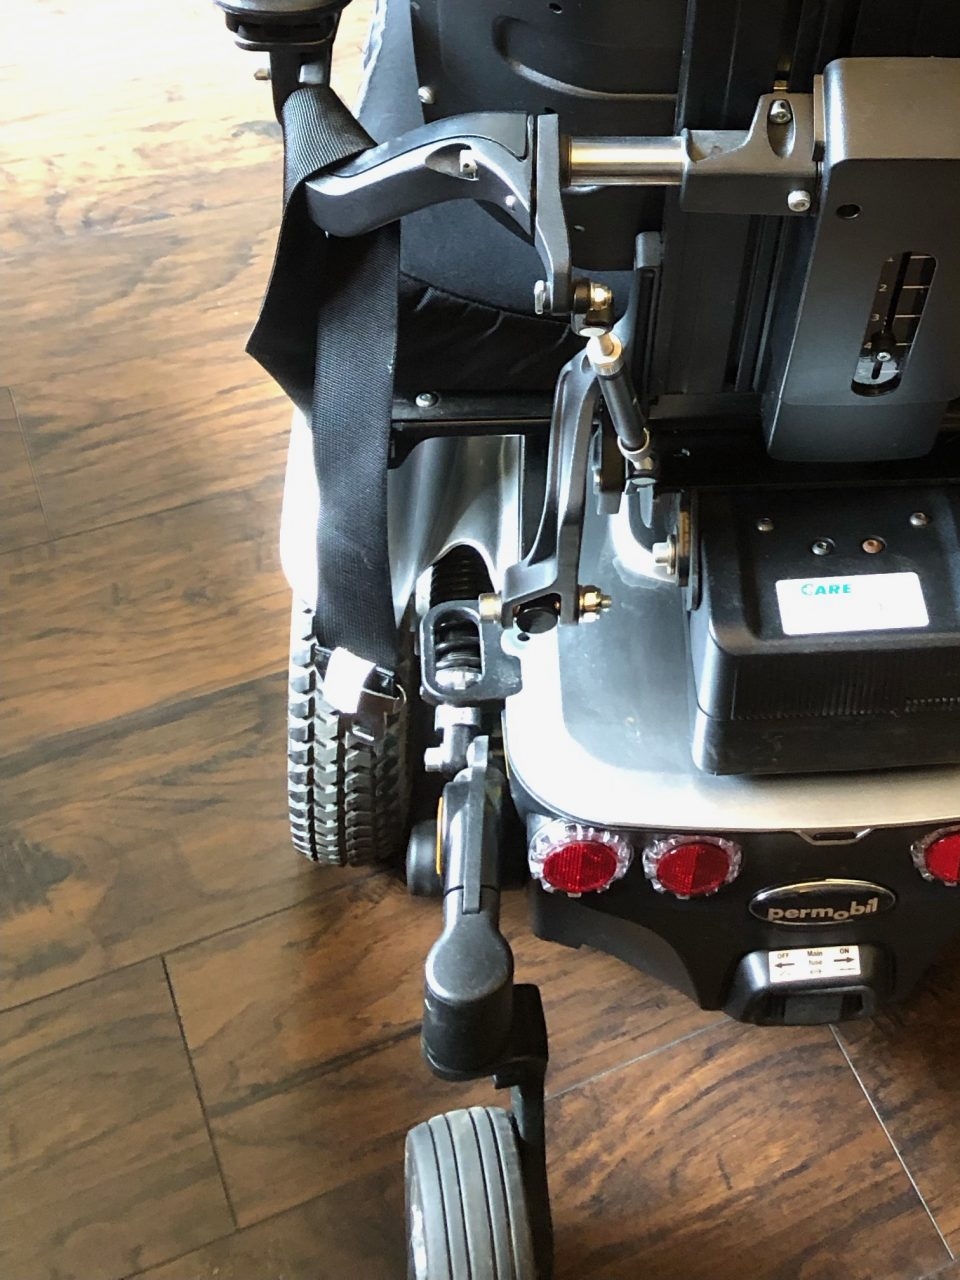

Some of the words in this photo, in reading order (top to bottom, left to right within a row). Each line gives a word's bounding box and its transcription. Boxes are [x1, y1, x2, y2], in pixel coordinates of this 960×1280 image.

[879, 283, 887, 292] 2
[872, 313, 880, 322] 3
[800, 583, 853, 596] CARE
[767, 897, 880, 921] permobil
